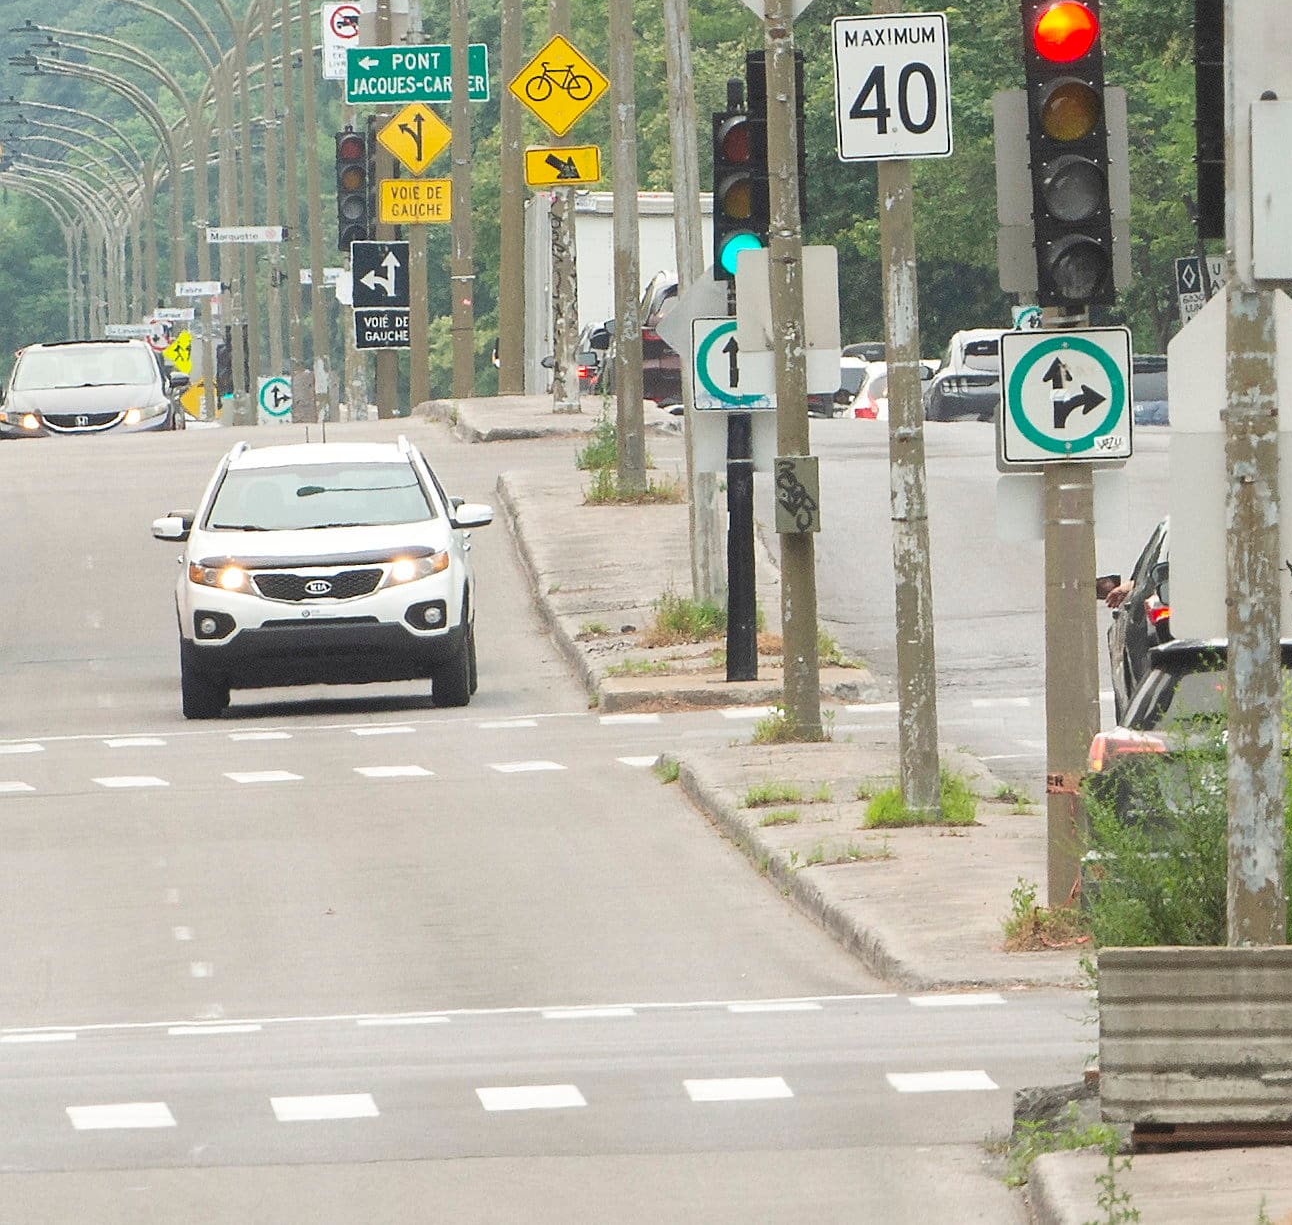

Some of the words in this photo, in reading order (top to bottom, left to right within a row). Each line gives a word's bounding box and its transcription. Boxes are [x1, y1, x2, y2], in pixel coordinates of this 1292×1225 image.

[845, 27, 935, 47] MAXIMUM
[392, 52, 440, 70] PONT
[350, 75, 485, 96] JACQUES-CARER
[849, 62, 937, 134] 40
[391, 186, 420, 200] VOIE
[427, 185, 442, 199] DE
[392, 204, 443, 217] GAUCHE
[396, 316, 409, 327] DE
[365, 331, 409, 342] GAUCHE
